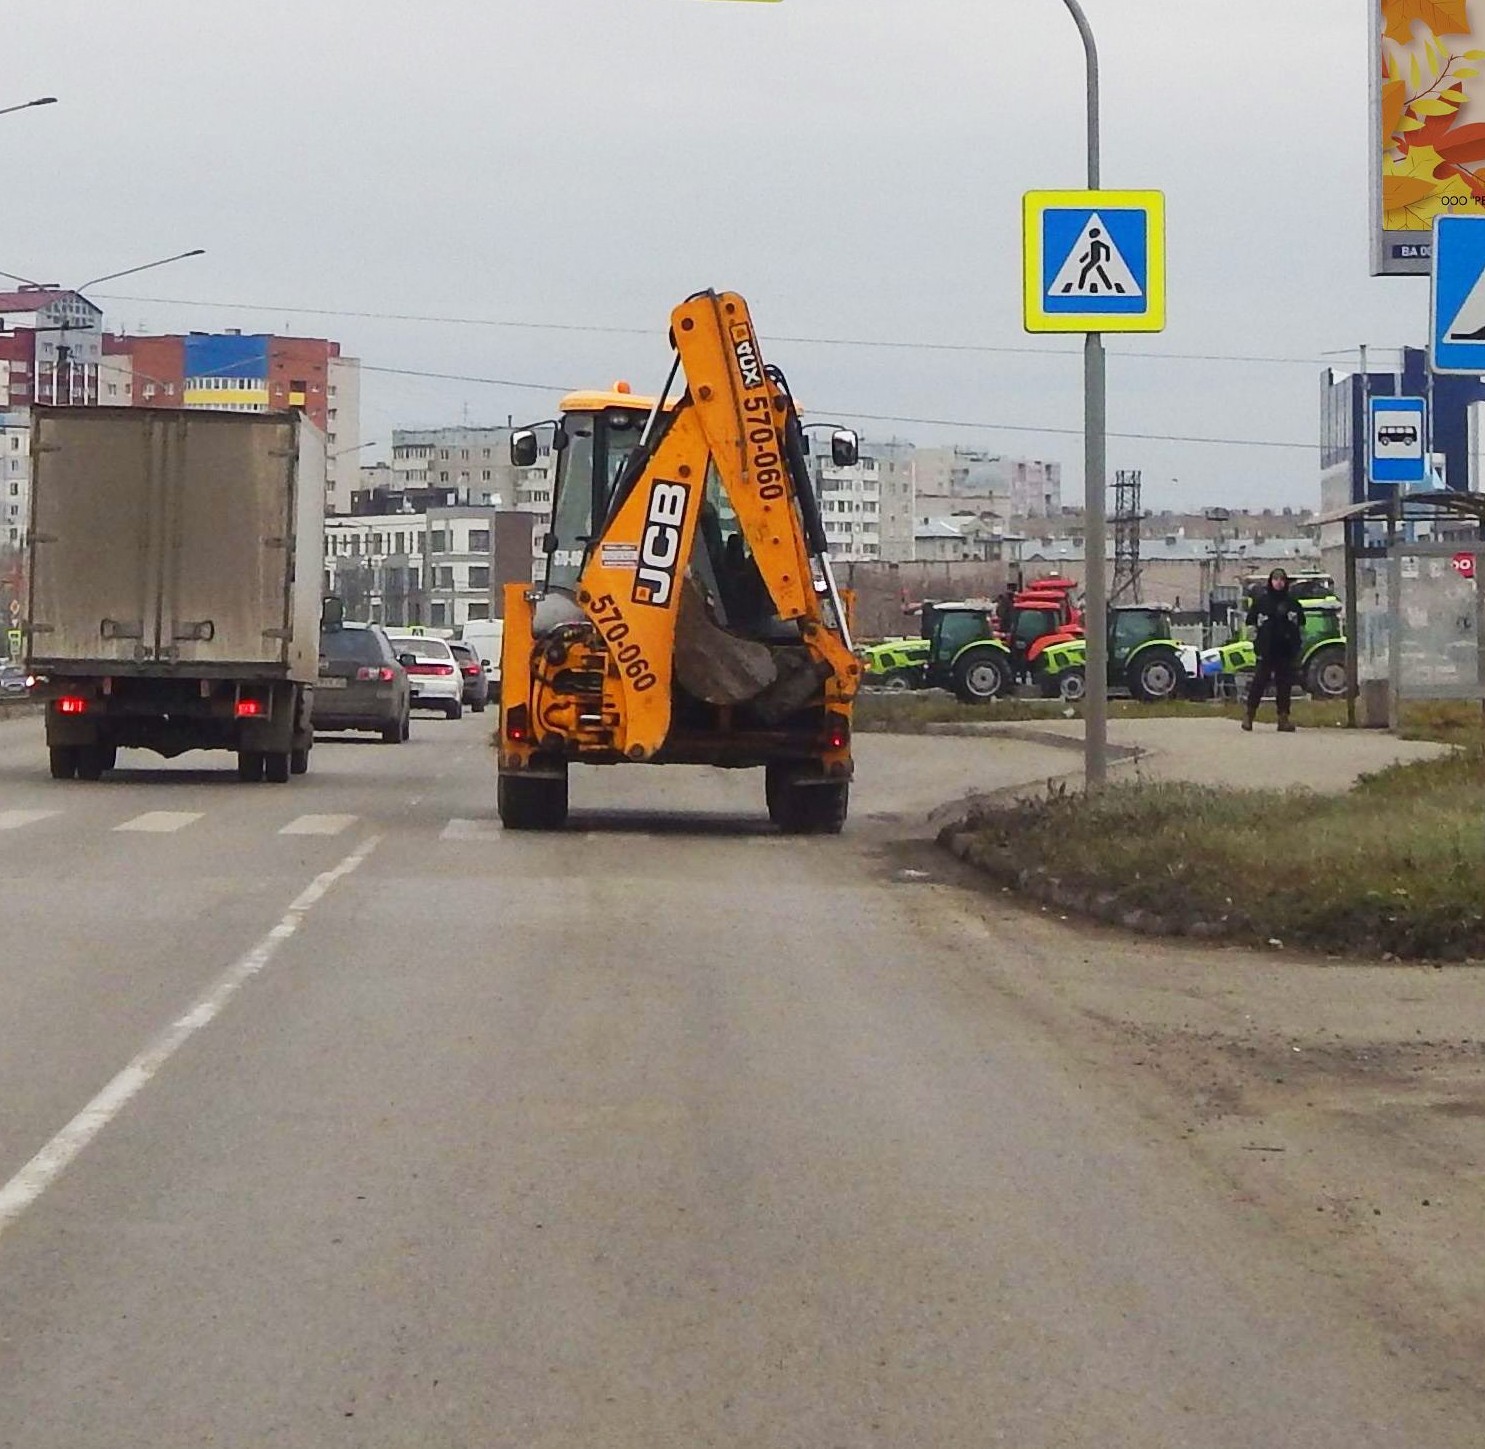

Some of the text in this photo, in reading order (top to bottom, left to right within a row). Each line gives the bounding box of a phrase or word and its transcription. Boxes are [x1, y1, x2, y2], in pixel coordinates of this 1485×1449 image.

[1441, 195, 1468, 206] ООО
[743, 396, 784, 502] 570-060
[639, 483, 687, 605] JCB
[589, 593, 657, 693] 570-060
